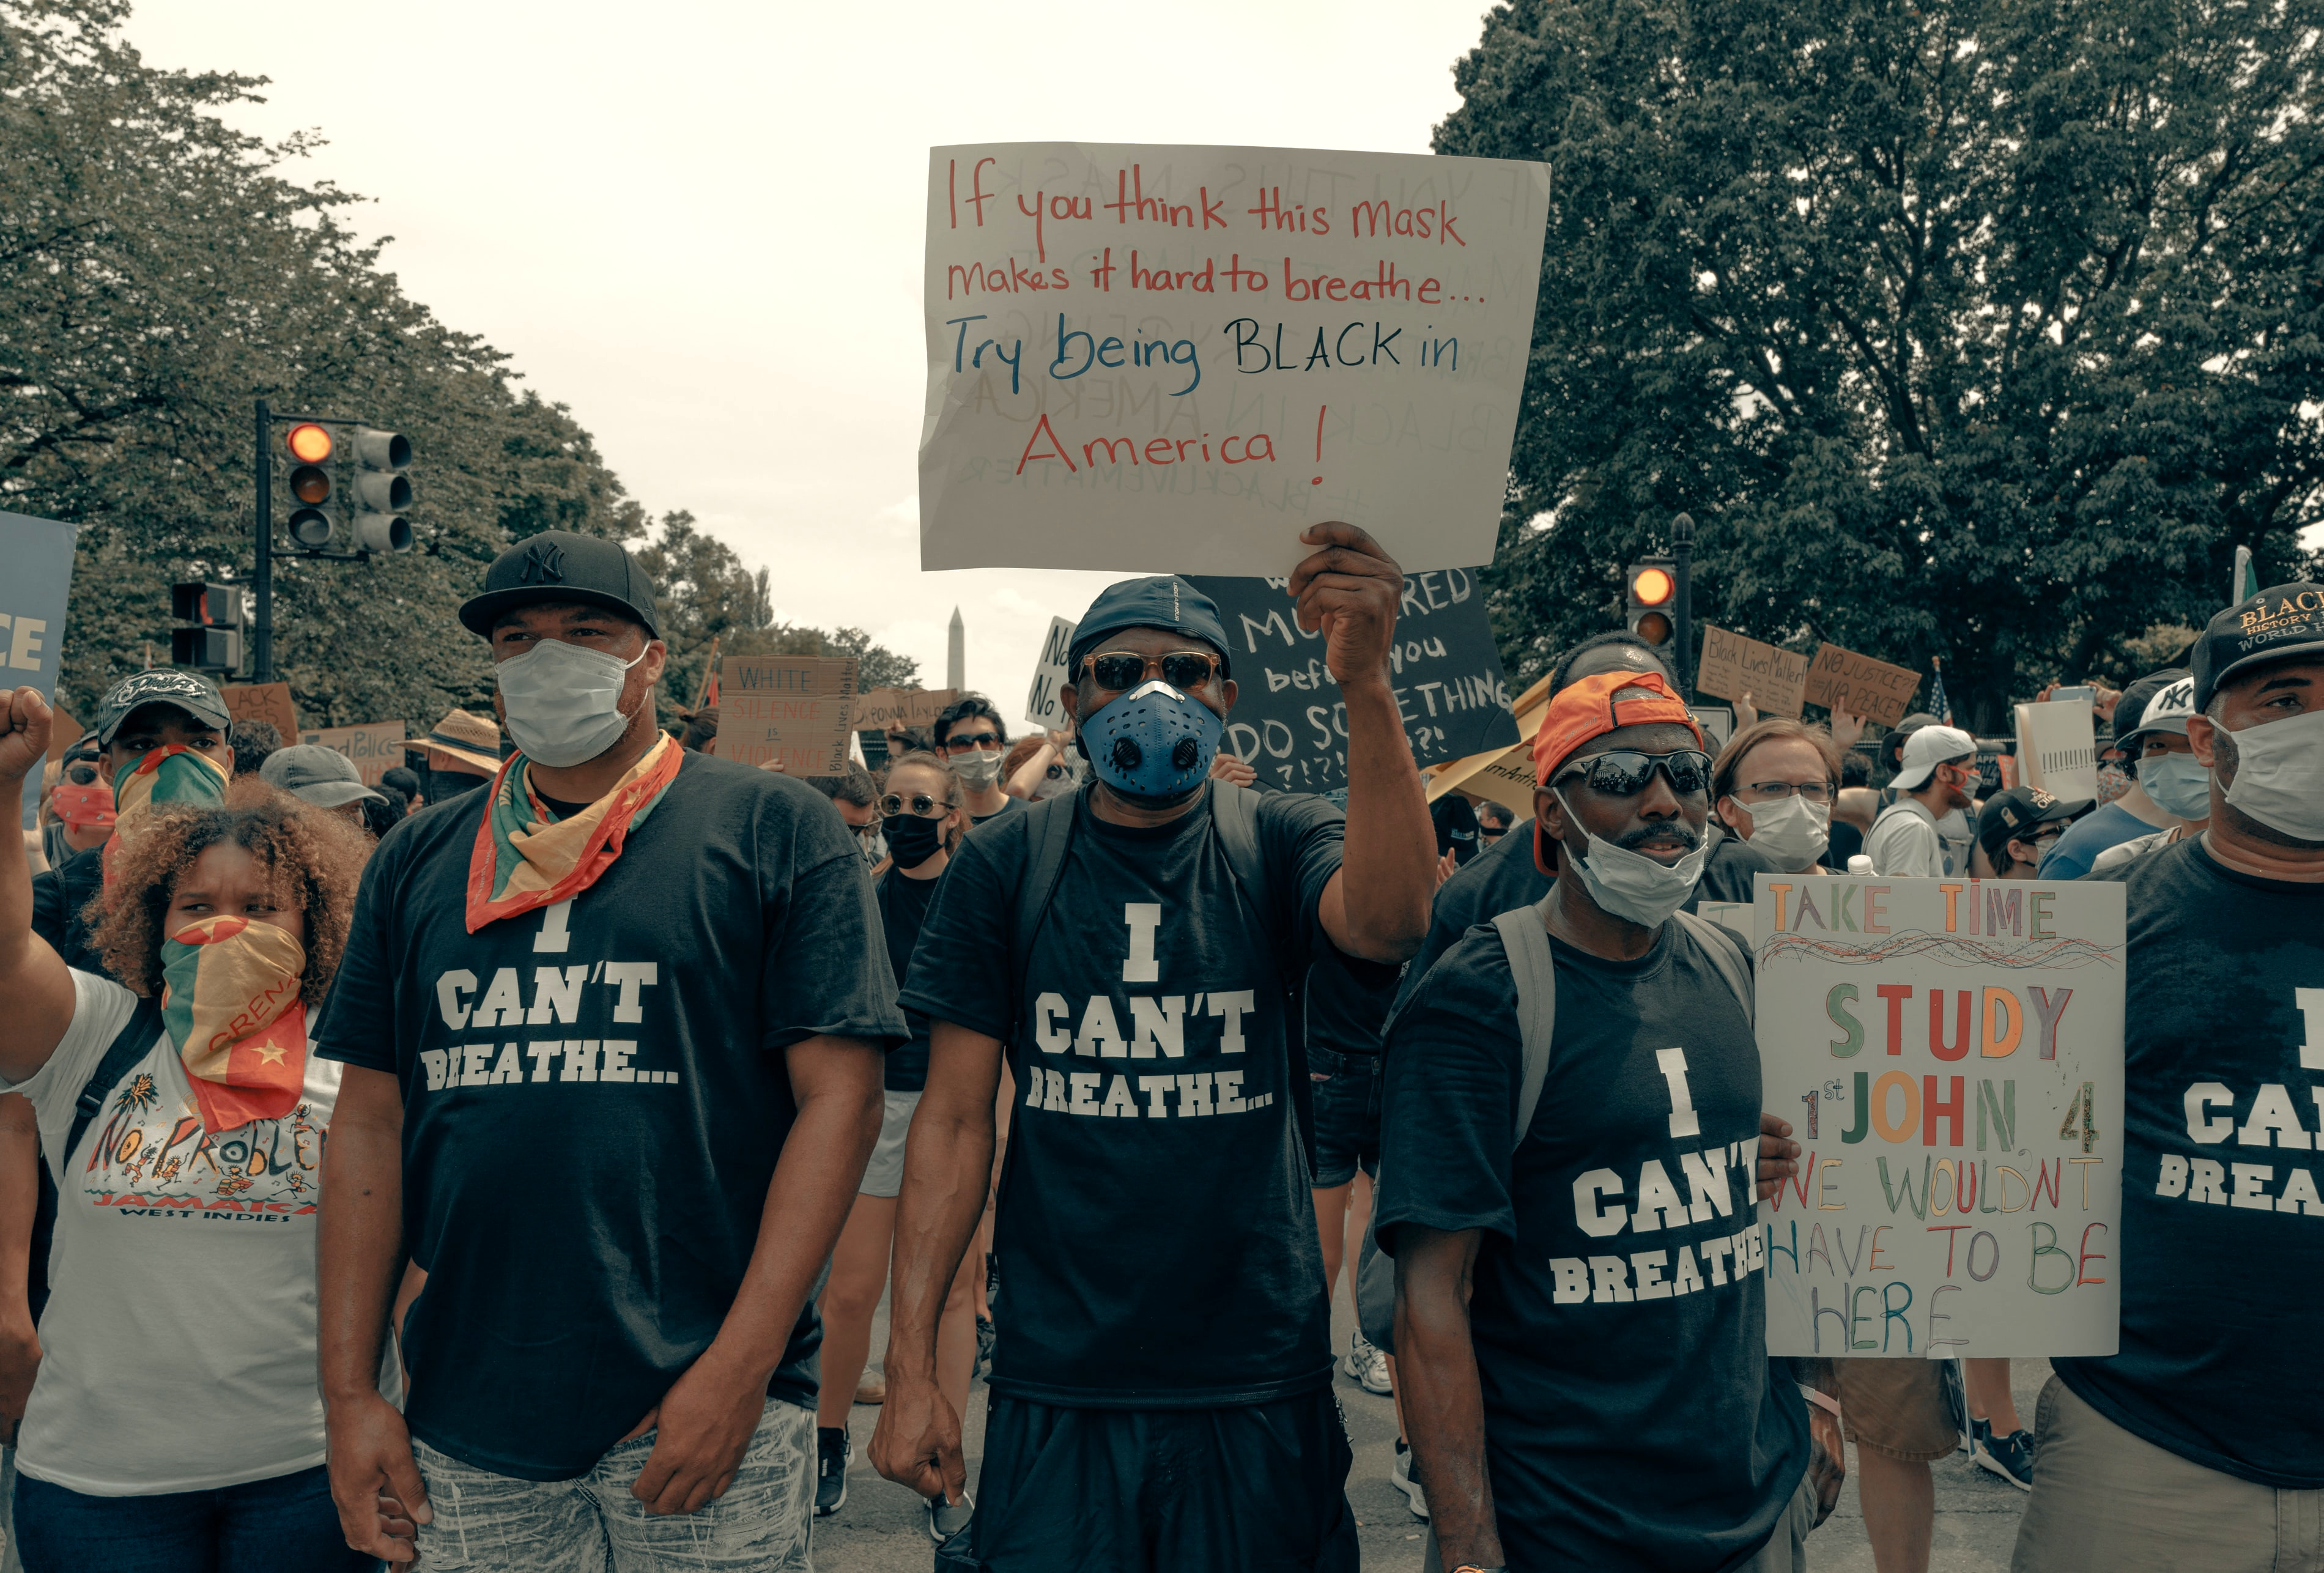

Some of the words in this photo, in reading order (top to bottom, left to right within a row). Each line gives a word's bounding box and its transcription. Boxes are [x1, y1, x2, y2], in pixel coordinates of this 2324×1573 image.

[949, 157, 996, 229] If
[1018, 190, 1093, 263] you
[1104, 163, 1227, 229] think
[1248, 185, 1330, 236] this
[1092, 247, 1117, 292] it
[1131, 250, 1214, 294] hard
[1220, 254, 1268, 294] to
[1284, 257, 1486, 304] breathe...
[946, 315, 1020, 394] Try
[1049, 313, 1200, 396] being
[1224, 318, 1402, 374] BLACK
[1420, 325, 1460, 372] in
[1016, 414, 1277, 475] America
[2238, 625, 2307, 652] WORLD
[2246, 613, 2311, 635] HISTORY
[739, 666, 812, 692] WHITE
[1390, 636, 1447, 673] you
[1708, 630, 1737, 665] Black
[1741, 645, 1767, 674] Lives
[221, 687, 280, 710] LACK
[838, 661, 854, 700] Matter
[1030, 674, 1055, 716] No
[731, 698, 821, 720] SILENCE
[834, 704, 849, 733] Lives
[1228, 720, 1294, 766] DO
[1306, 668, 1515, 750] SOETHING
[829, 738, 844, 772] Black
[1769, 883, 1891, 935] TAKE
[1122, 903, 1161, 982] I
[436, 960, 658, 1031] CAN'T
[1825, 983, 2074, 1062] STUDY
[1035, 989, 1256, 1059] CAN'T
[420, 1040, 679, 1092] BREATHE...
[1025, 1065, 1273, 1119] BREATHE...
[1655, 1047, 1700, 1139] I
[1840, 1069, 2016, 1152] JOHN
[2057, 1081, 2100, 1155] 4
[1572, 1134, 1761, 1238] CAN'T
[1769, 1152, 1848, 1213] WE
[119, 1207, 196, 1219] WEST
[202, 1211, 290, 1223] INDIES
[1766, 1220, 1895, 1279] HAVE
[1926, 1224, 2000, 1282] TO
[2027, 1221, 2108, 1296] BE
[1810, 1281, 1971, 1355] HERE
